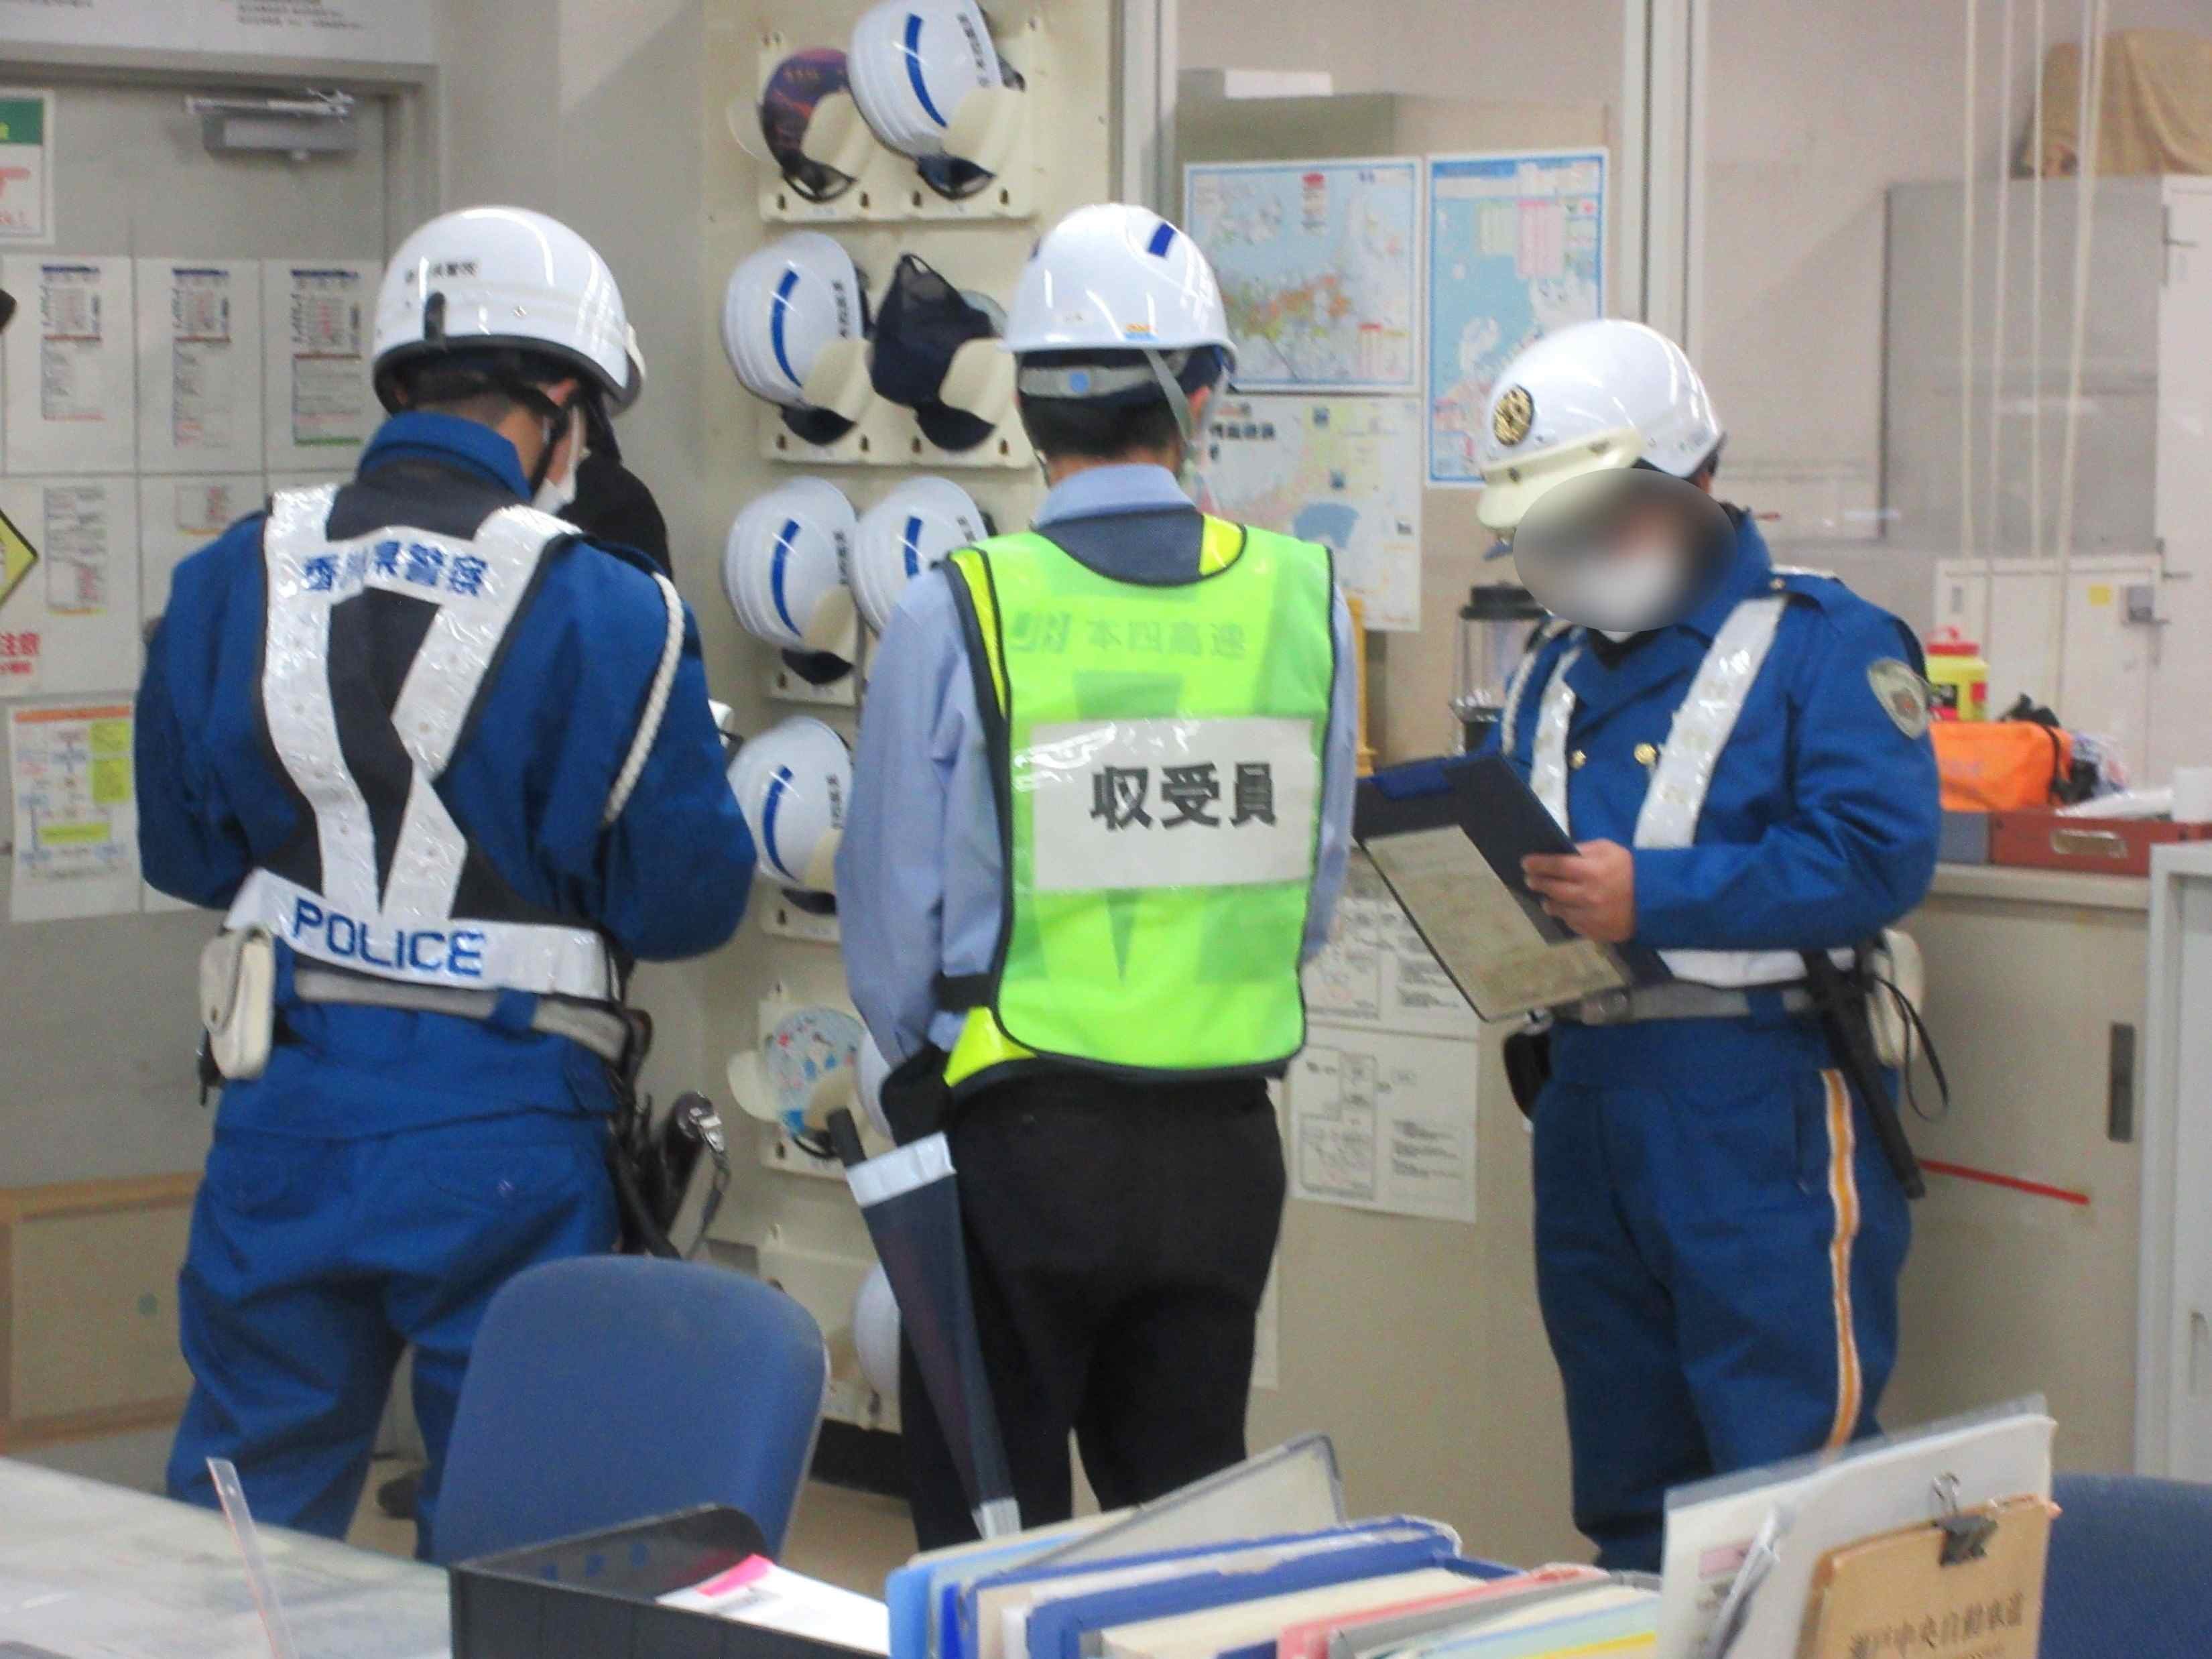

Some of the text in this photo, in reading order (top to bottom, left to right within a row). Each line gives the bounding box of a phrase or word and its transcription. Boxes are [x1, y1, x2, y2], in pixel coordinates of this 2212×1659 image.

[1090, 762, 1277, 831] 収受員
[292, 897, 485, 977] POLICE
